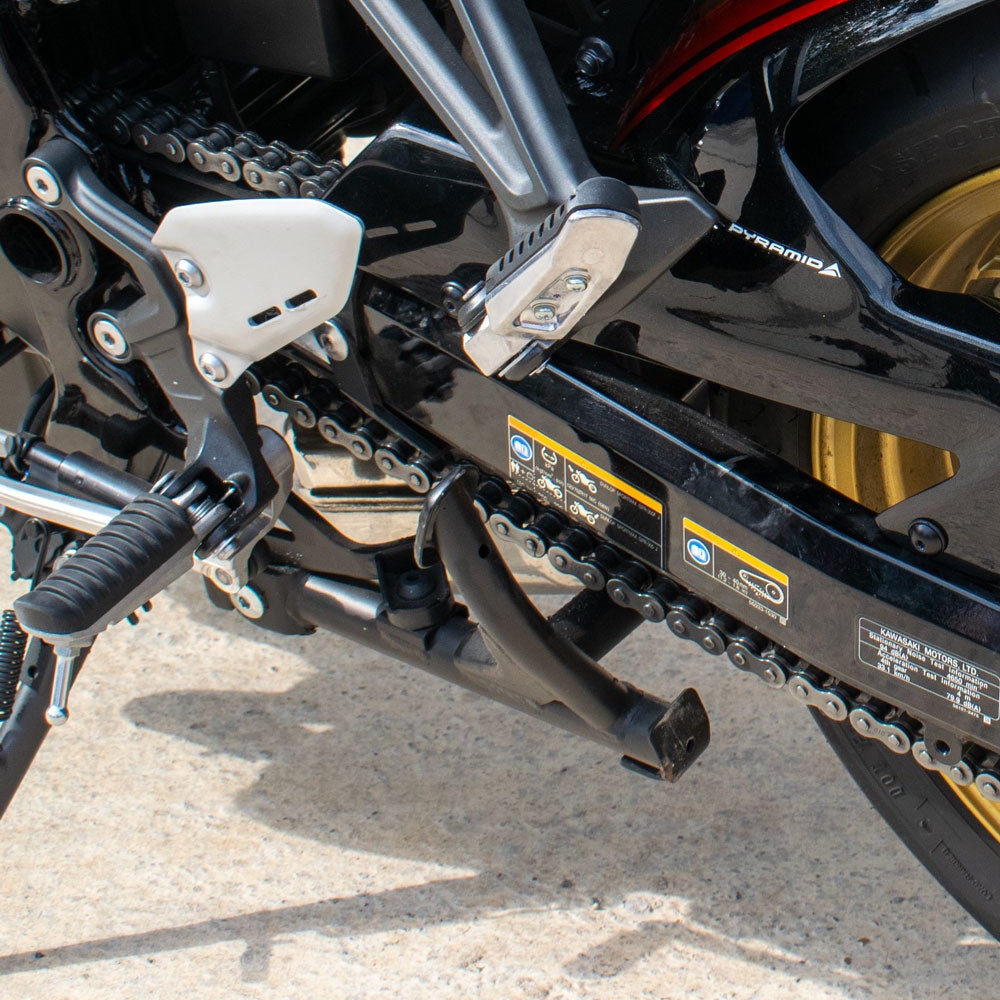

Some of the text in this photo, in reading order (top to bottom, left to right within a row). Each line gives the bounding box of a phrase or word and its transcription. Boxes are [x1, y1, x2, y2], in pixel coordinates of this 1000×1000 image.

[728, 222, 825, 271] PYRAMID
[868, 631, 988, 689] Stationary Noise Test Information
[877, 650, 981, 699] Acceleration Test Information
[880, 627, 921, 651] KAWASAKI
[962, 663, 979, 677] LTD.
[893, 668, 911, 682] km/h
